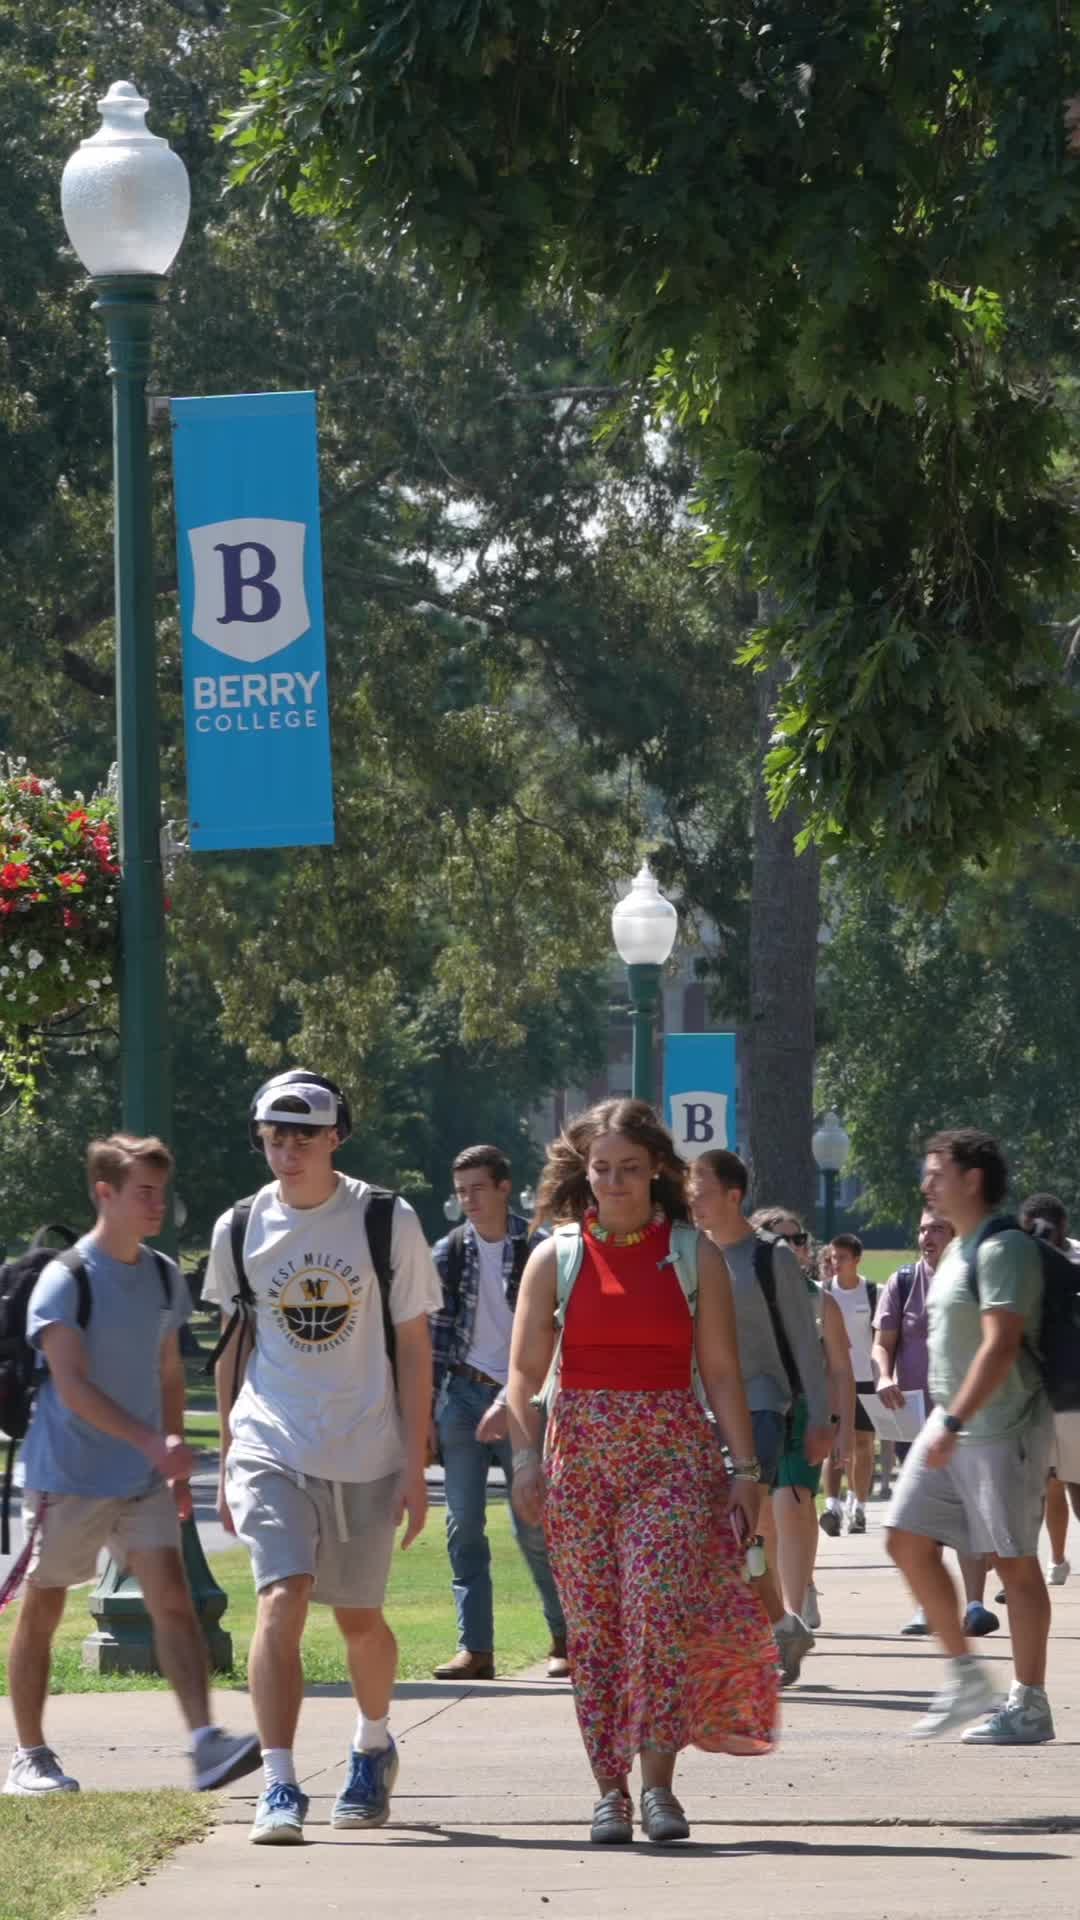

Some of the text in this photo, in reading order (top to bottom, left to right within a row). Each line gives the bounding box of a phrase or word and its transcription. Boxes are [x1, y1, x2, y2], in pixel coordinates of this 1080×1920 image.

[213, 541, 282, 625] B
[193, 671, 321, 711] BERRY
[195, 709, 318, 733] COLLEGE
[681, 1103, 714, 1143] B
[267, 1260, 297, 1299] WEST
